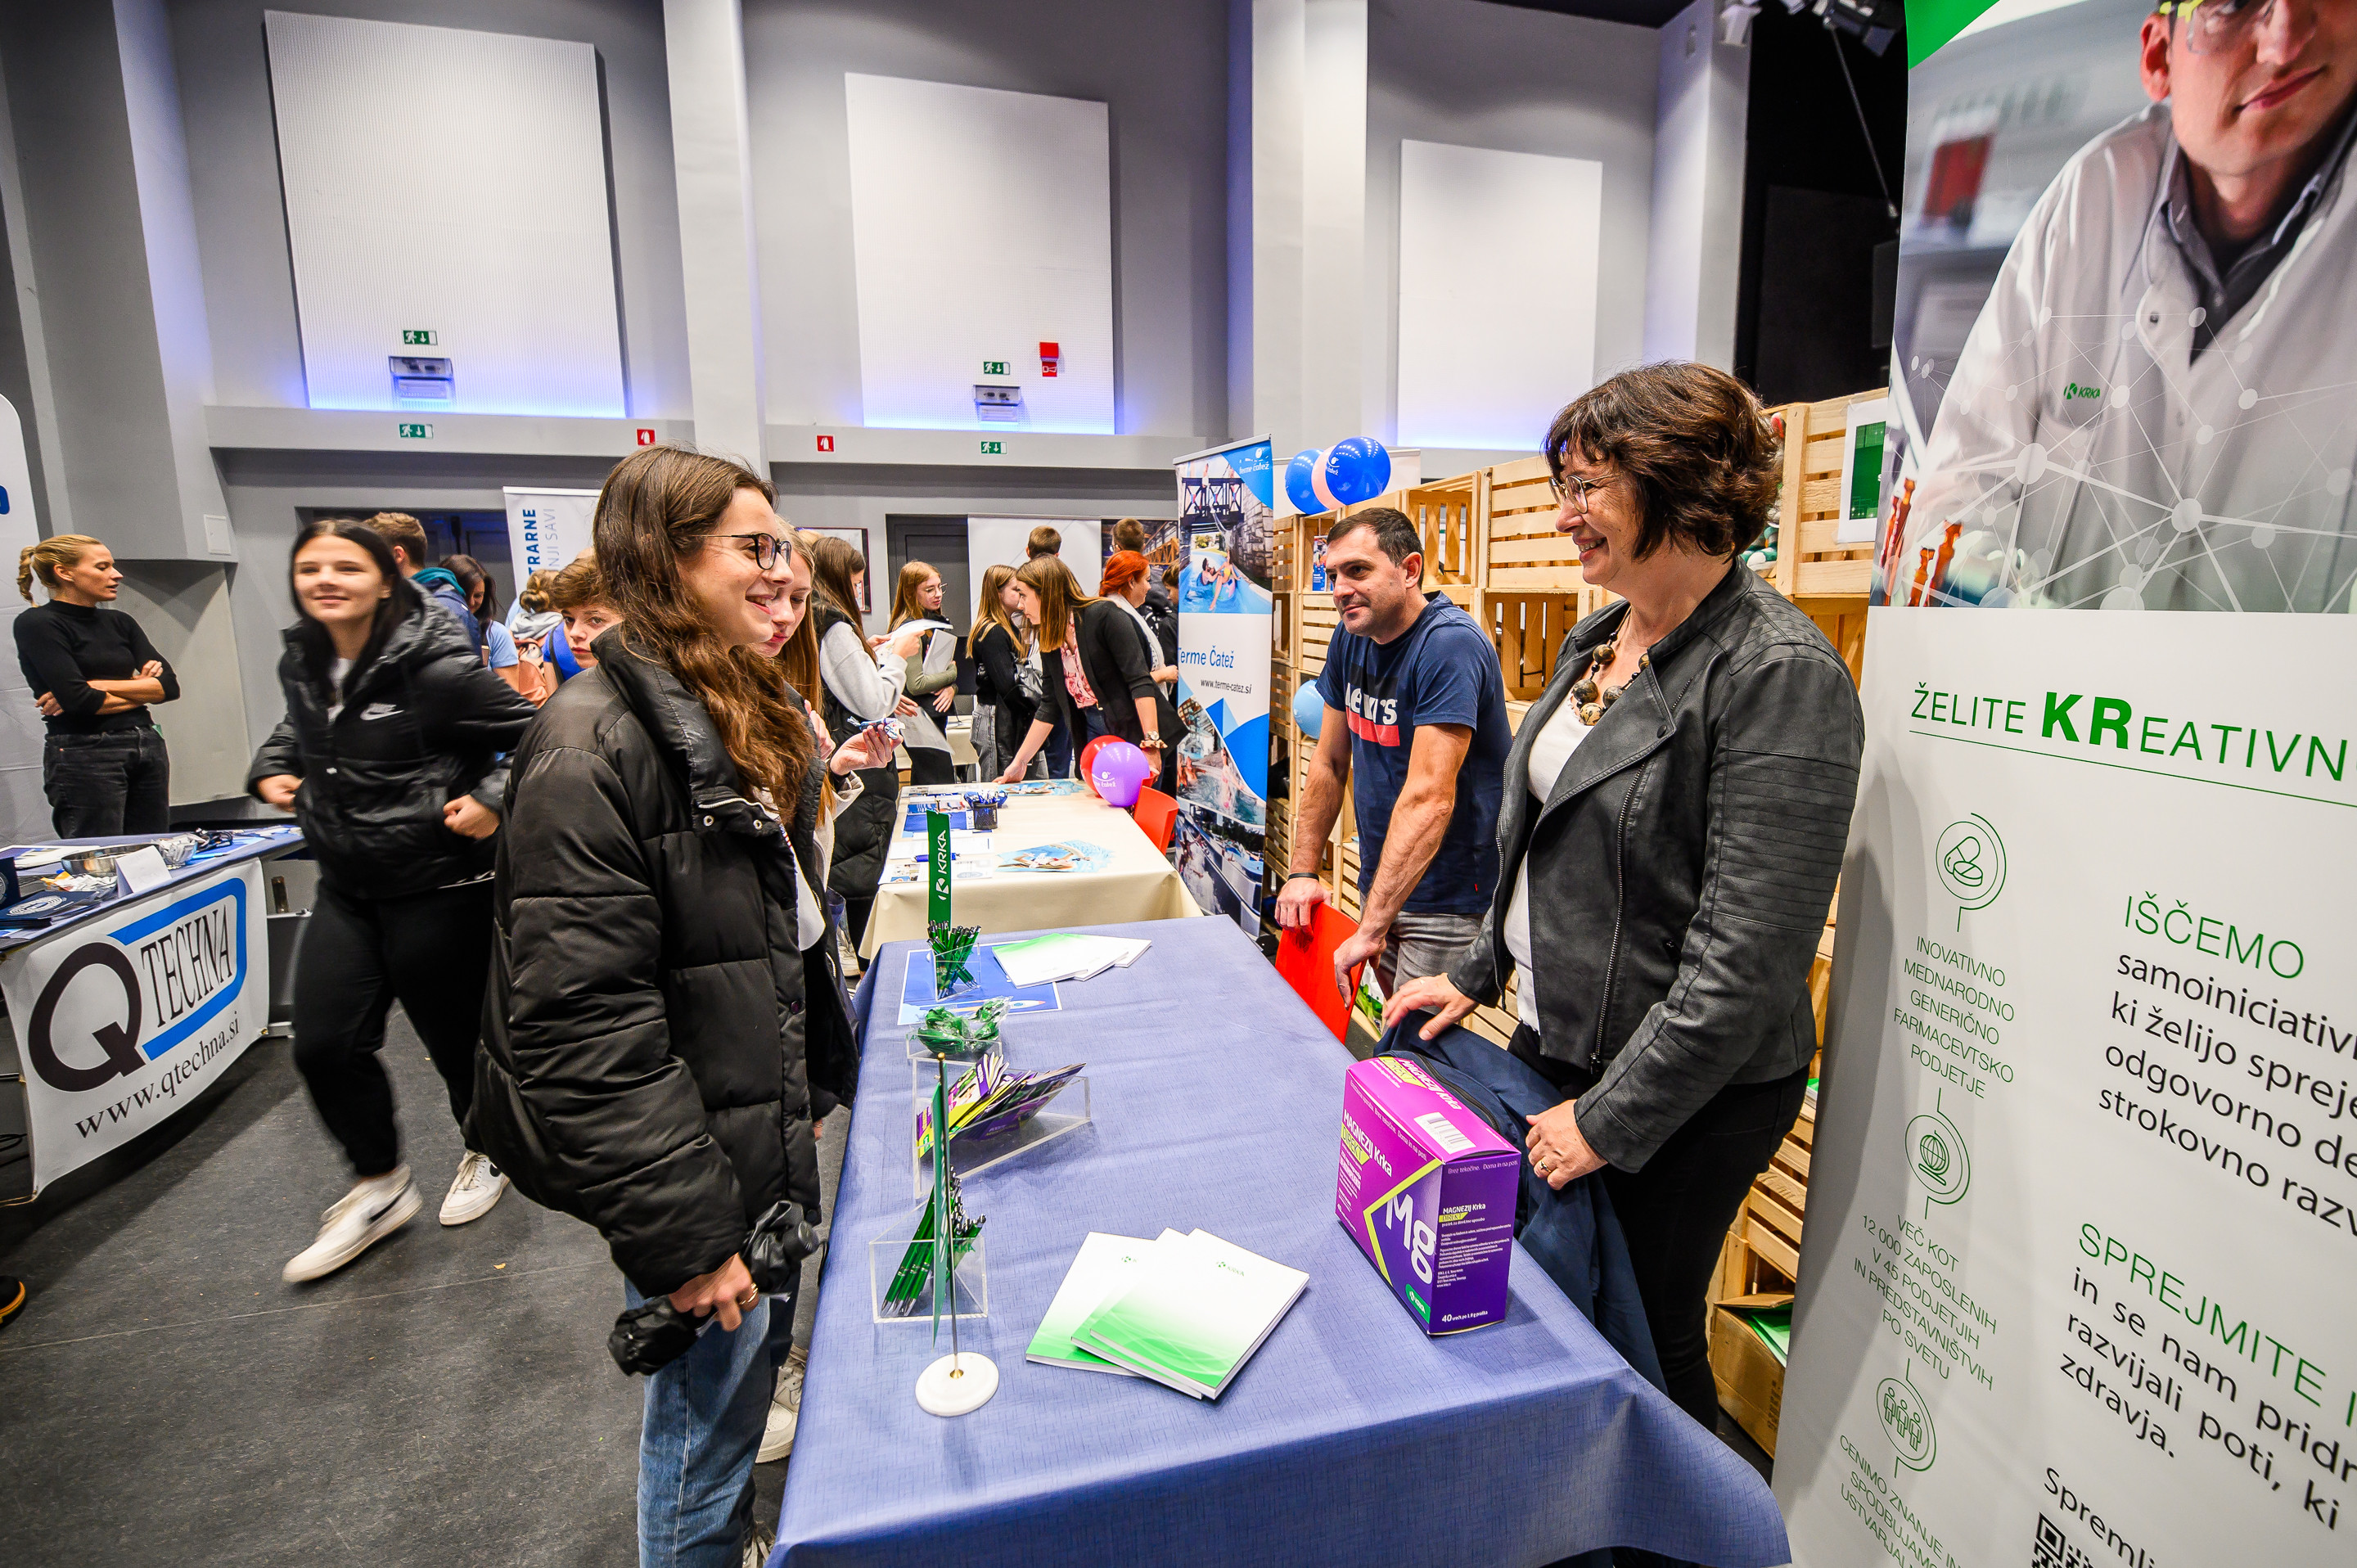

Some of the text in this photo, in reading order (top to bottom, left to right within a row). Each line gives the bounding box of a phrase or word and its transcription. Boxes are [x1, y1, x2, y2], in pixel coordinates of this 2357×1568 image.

[2078, 386, 2101, 399] KRKA
[543, 508, 558, 541] SAVI
[1178, 645, 1234, 669] erme Čatež
[1201, 679, 1252, 695] www.terme-catez.si
[1911, 682, 2357, 782] ŽELITE KREATIVN
[937, 829, 948, 875] KRKA
[1916, 935, 2006, 987] INOVATIVNO
[2125, 890, 2304, 979] IŠČEMO
[1904, 957, 2015, 1021] MEDNARODNO
[1910, 989, 1999, 1045] GENERIČNO
[2117, 953, 2357, 1061] samoiniciativ
[1894, 1007, 2014, 1083] FARMACEVTSKO
[2111, 990, 2138, 1027] ki
[2144, 1004, 2237, 1065] želijo
[74, 1010, 241, 1139] www.qtechna.si
[1910, 1043, 1986, 1099] PODJETJE
[2105, 1045, 2302, 1148] odgovorno
[1342, 1125, 1363, 1161] DIREKT
[1343, 1108, 1373, 1160] MAGNEZIJ
[1374, 1146, 1393, 1178] Krka
[2098, 1088, 2269, 1187] strokovno
[1386, 1193, 1437, 1285] Mg
[1443, 1203, 1486, 1214] MAGNEZIJ Krka
[1897, 1214, 1959, 1273] VEČ KOT
[1863, 1214, 1997, 1335] 12 000 ZAPOSLENIH
[1873, 1246, 1980, 1350] V 45 PODJETJIH
[1441, 1313, 1453, 1323] 40
[1854, 1257, 1994, 1392] IN PREDSTAVNIŠTVIH
[1882, 1309, 1949, 1380] PO SVETU
[2072, 1266, 2098, 1305] in
[2112, 1301, 2146, 1337] se
[2161, 1332, 2238, 1404] nam
[2079, 1223, 2327, 1408] SPREJMITE
[2059, 1352, 2175, 1459] zdravja.
[2066, 1313, 2341, 1531] razvijali poti, ki
[1839, 1434, 1887, 1495] CENIMO
[1889, 1489, 1944, 1561] ZNANJE
